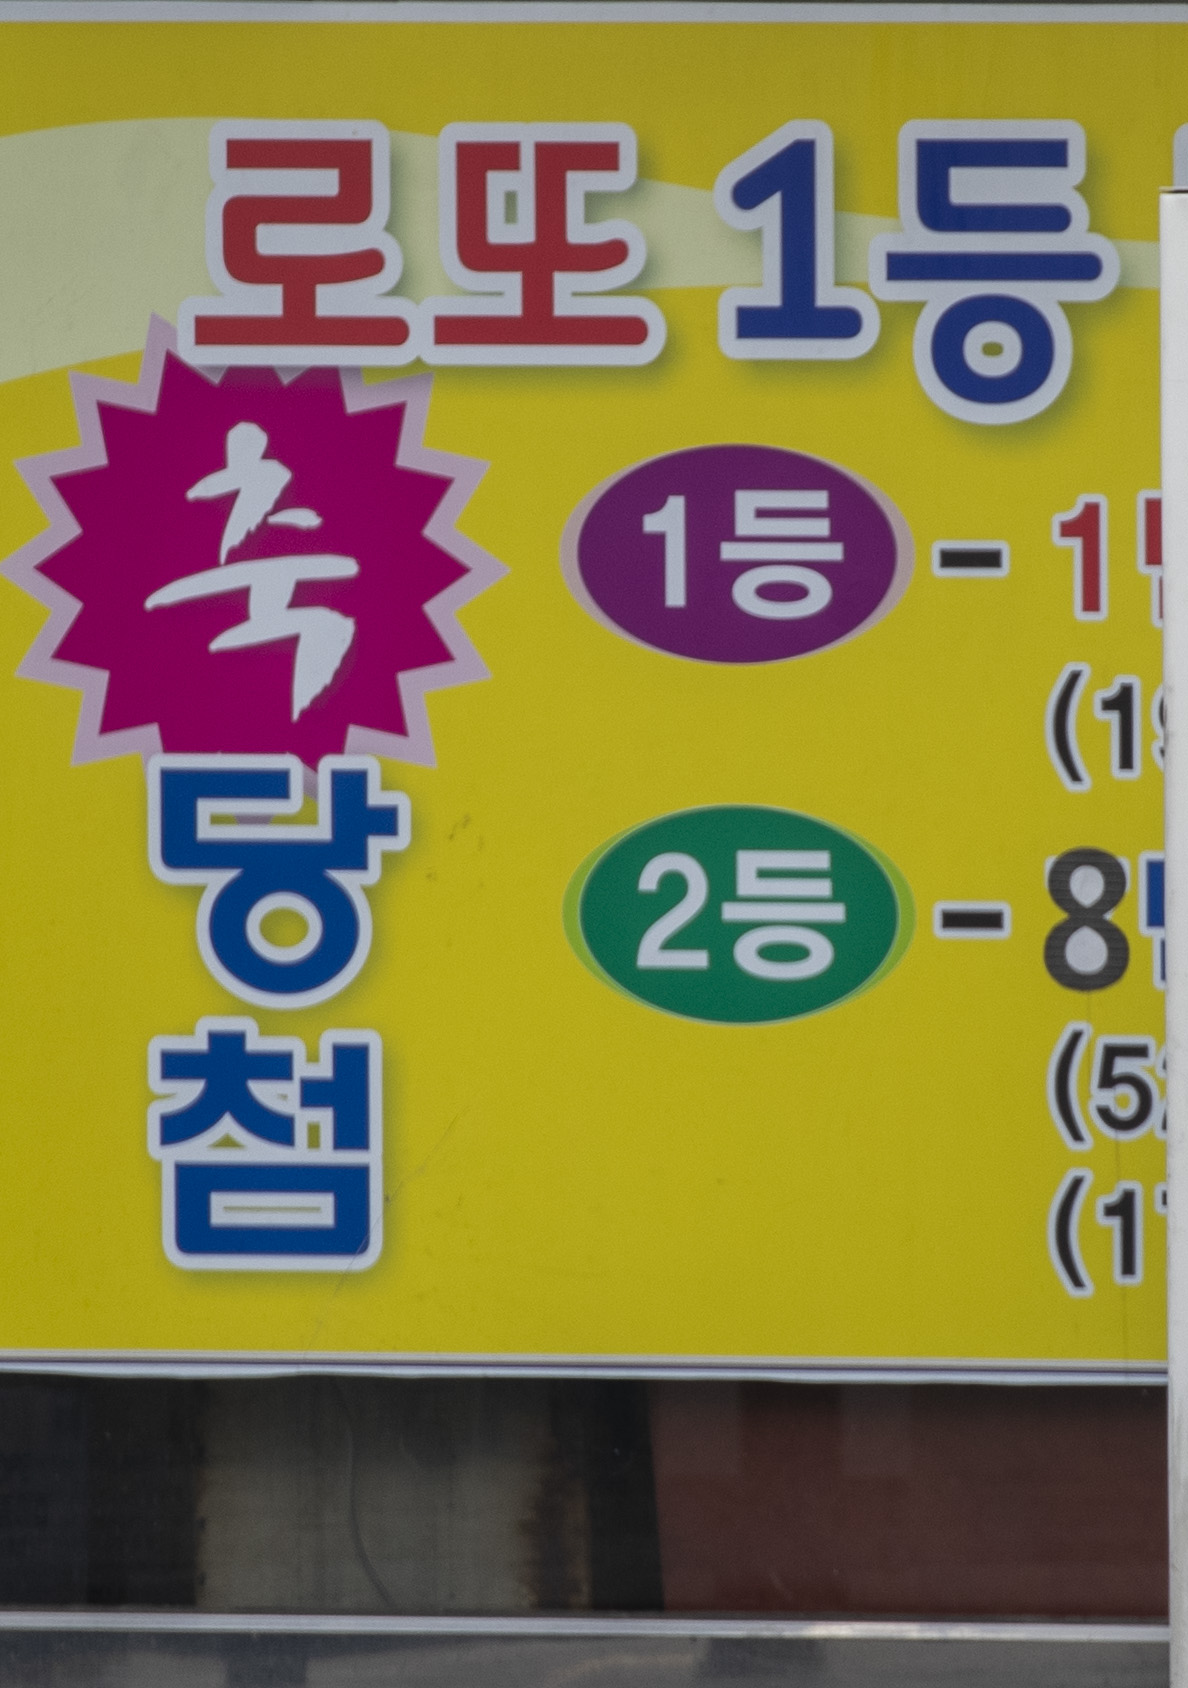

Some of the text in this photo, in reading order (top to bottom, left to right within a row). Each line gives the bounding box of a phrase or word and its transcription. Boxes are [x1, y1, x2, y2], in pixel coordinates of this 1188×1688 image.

[188, 130, 1110, 412] 로또 1등
[642, 489, 844, 620] 1등
[143, 421, 405, 1262] 축 당첨
[636, 849, 846, 981] 2등
[1052, 1026, 1166, 1146] (5
[1052, 1172, 1166, 1294] (1
